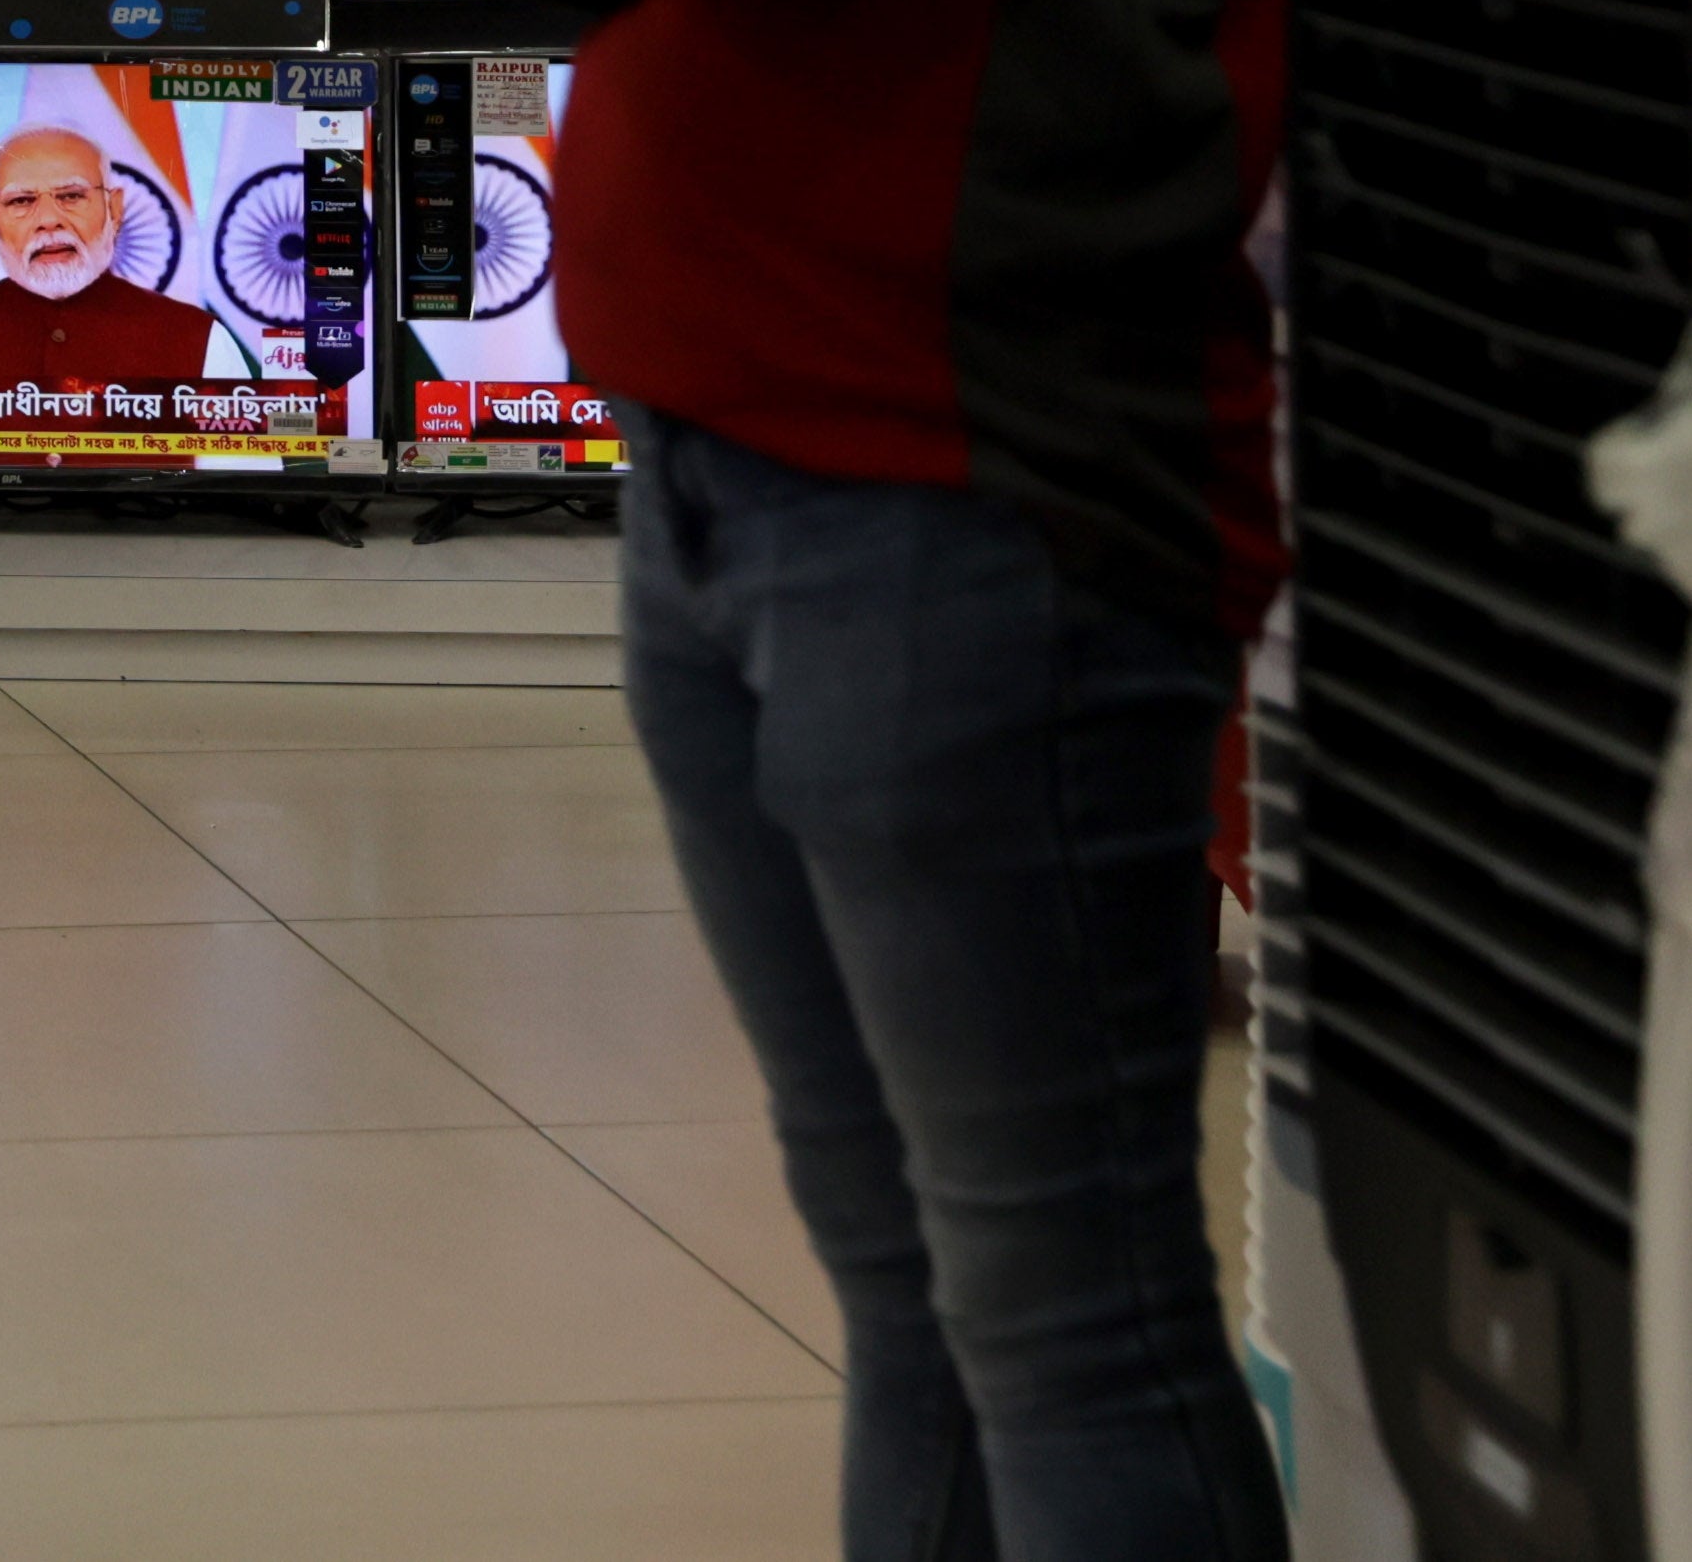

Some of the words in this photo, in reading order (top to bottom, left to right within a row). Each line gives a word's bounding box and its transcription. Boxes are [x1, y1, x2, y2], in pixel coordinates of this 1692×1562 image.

[111, 6, 163, 25] BPL
[162, 63, 261, 76] PROUDLY
[477, 62, 544, 74] RAIPUR
[287, 65, 307, 99] 2
[309, 67, 363, 87] YEAR
[477, 74, 545, 82] ELECTRONICS
[162, 80, 262, 98] INDIAN
[309, 88, 363, 98] WARRANTY
[411, 84, 438, 94] BPL
[317, 233, 351, 244] NETFLIX
[327, 267, 354, 277] YouTube
[415, 302, 455, 310] INDIAN
[104, 384, 163, 420] দিয়ে
[427, 402, 457, 415] abp
[483, 388, 561, 425] 'আমি
[194, 418, 255, 431] TATA
